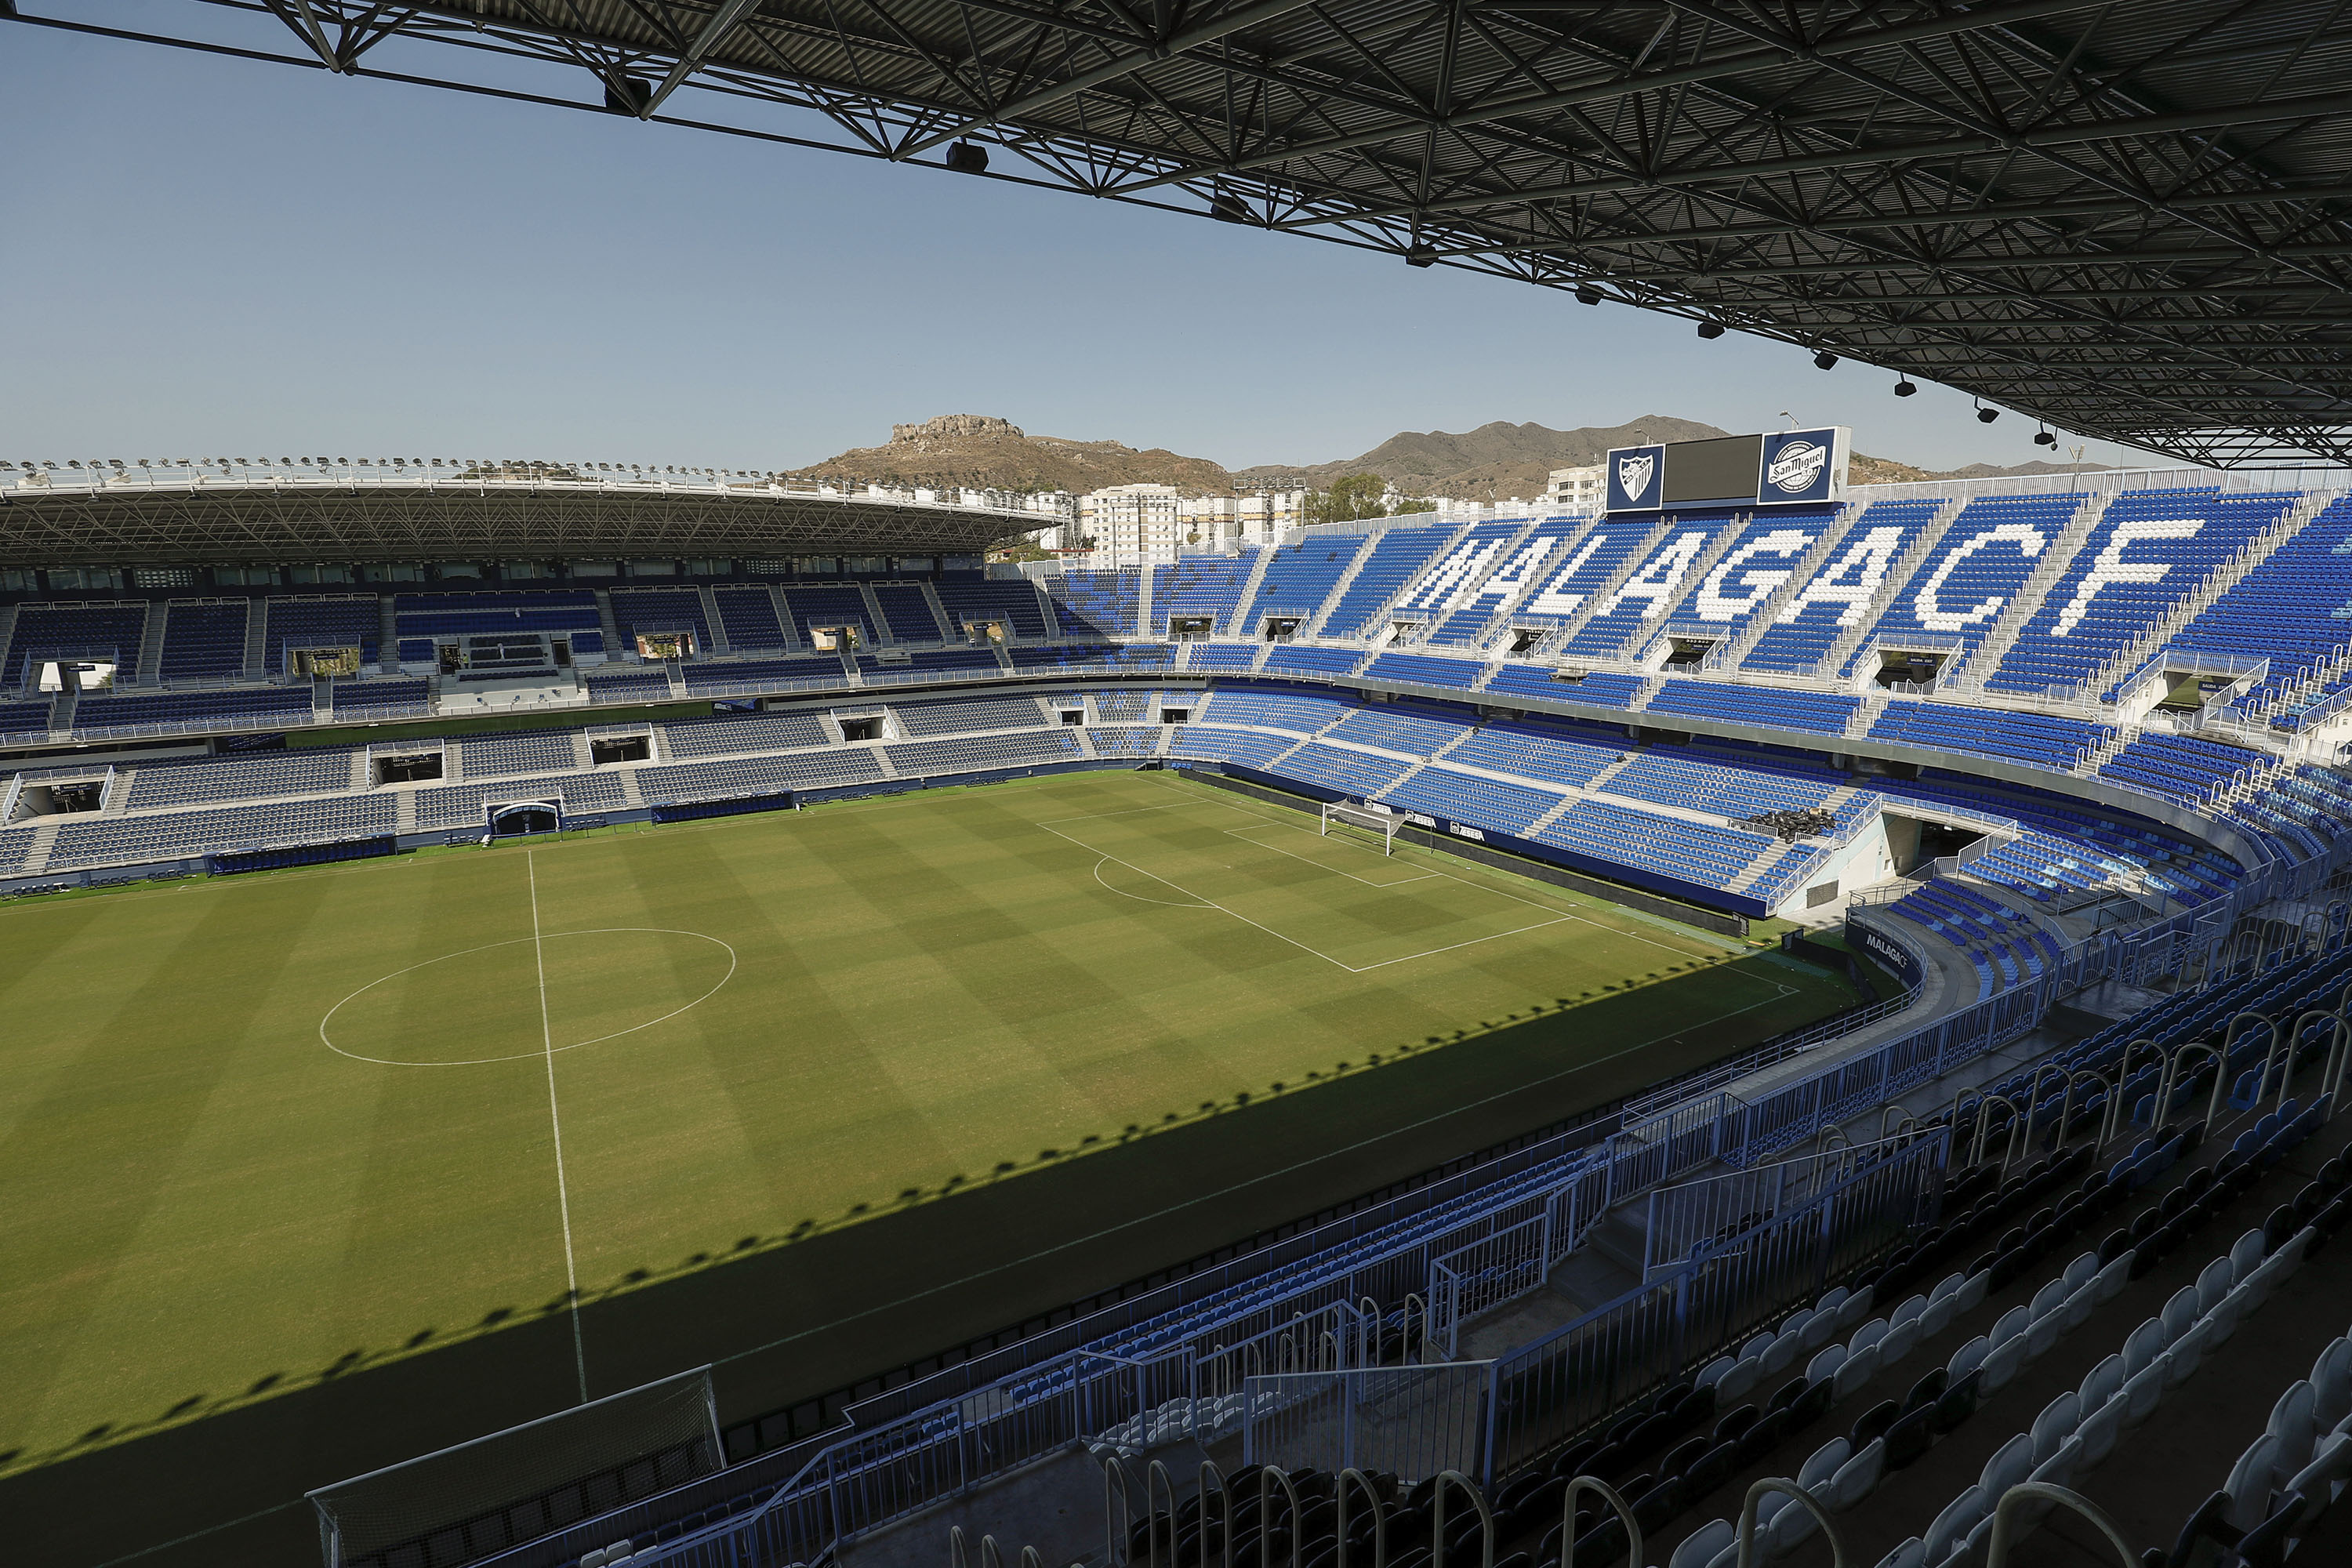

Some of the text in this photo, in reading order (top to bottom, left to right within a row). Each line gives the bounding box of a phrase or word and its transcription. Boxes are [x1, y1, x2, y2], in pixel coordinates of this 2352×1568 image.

[1769, 465, 1791, 482] San
[1790, 450, 1823, 470] Miguel
[1460, 826, 1485, 841] TESESA
